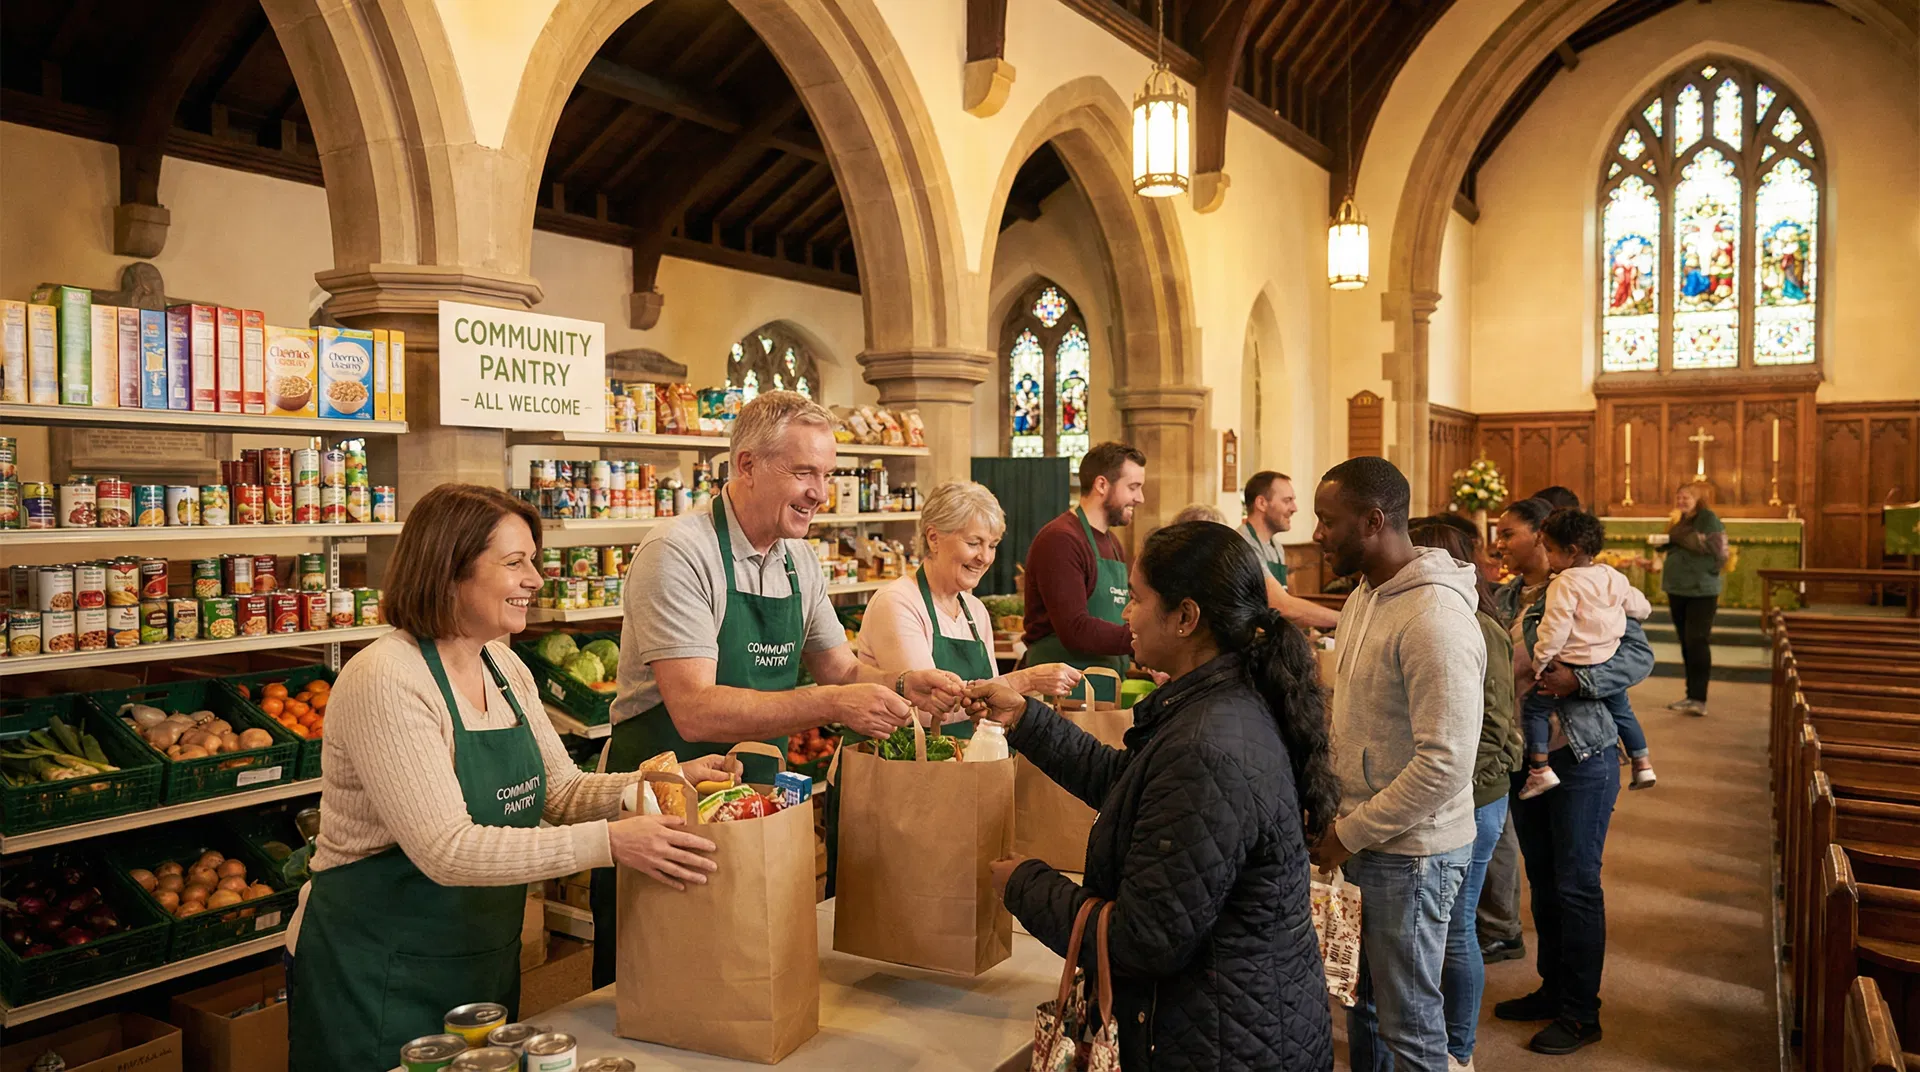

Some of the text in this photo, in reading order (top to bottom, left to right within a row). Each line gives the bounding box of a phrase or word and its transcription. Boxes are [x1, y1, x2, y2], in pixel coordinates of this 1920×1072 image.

[455, 317, 592, 357] COMMUNITY
[480, 354, 571, 387] PANTRY
[474, 391, 581, 416] ALL WELCOME
[747, 640, 796, 655] COMMUNITY
[754, 654, 789, 667] PANTRY
[504, 793, 536, 816] PANTRY
